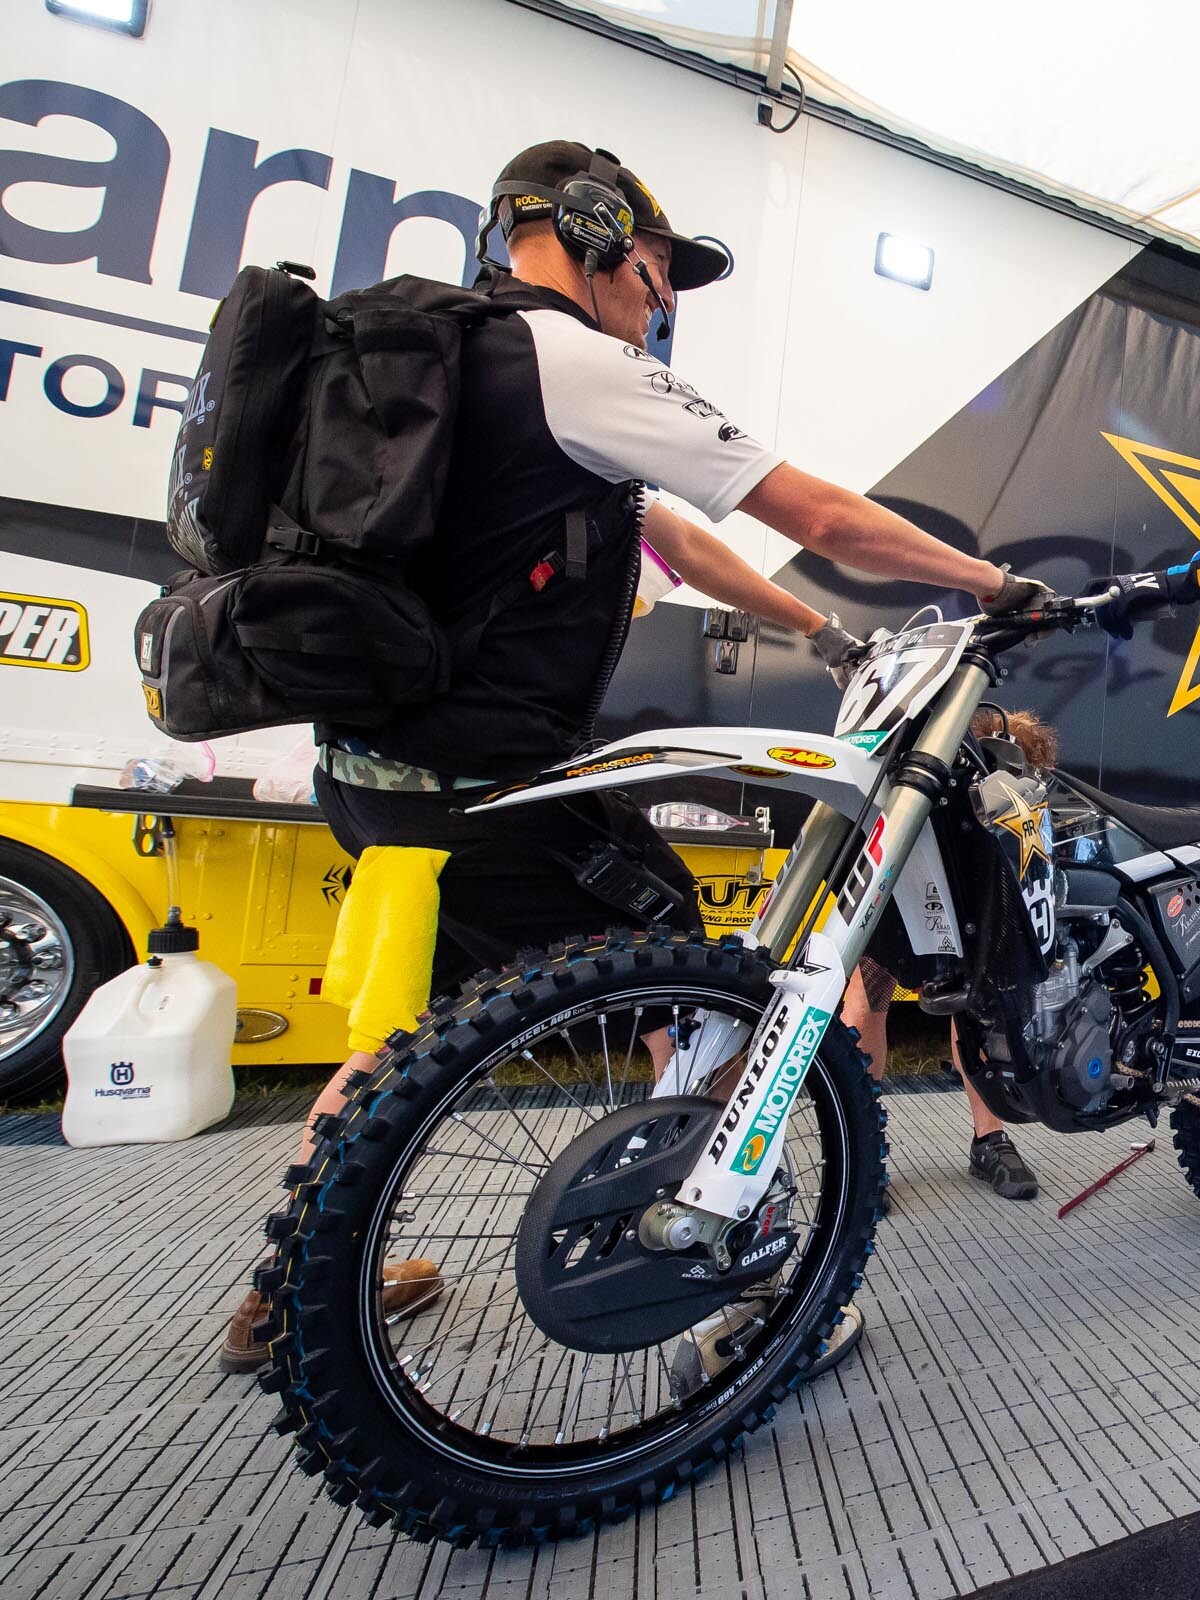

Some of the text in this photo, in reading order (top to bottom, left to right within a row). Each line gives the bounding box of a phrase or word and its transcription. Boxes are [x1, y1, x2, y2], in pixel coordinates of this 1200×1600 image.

[834, 647, 948, 737] 67
[566, 752, 655, 777] ROCKSTAR
[769, 747, 834, 769] FMF
[511, 1023, 549, 1049] EXCEL
[550, 1010, 572, 1027] A60
[708, 1004, 789, 1166] DUNLOP
[754, 1014, 827, 1134] MOTOREX
[95, 1085, 152, 1100] Husqvarna
[740, 1236, 787, 1267] GALFER
[735, 1356, 765, 1386] EXCEL
